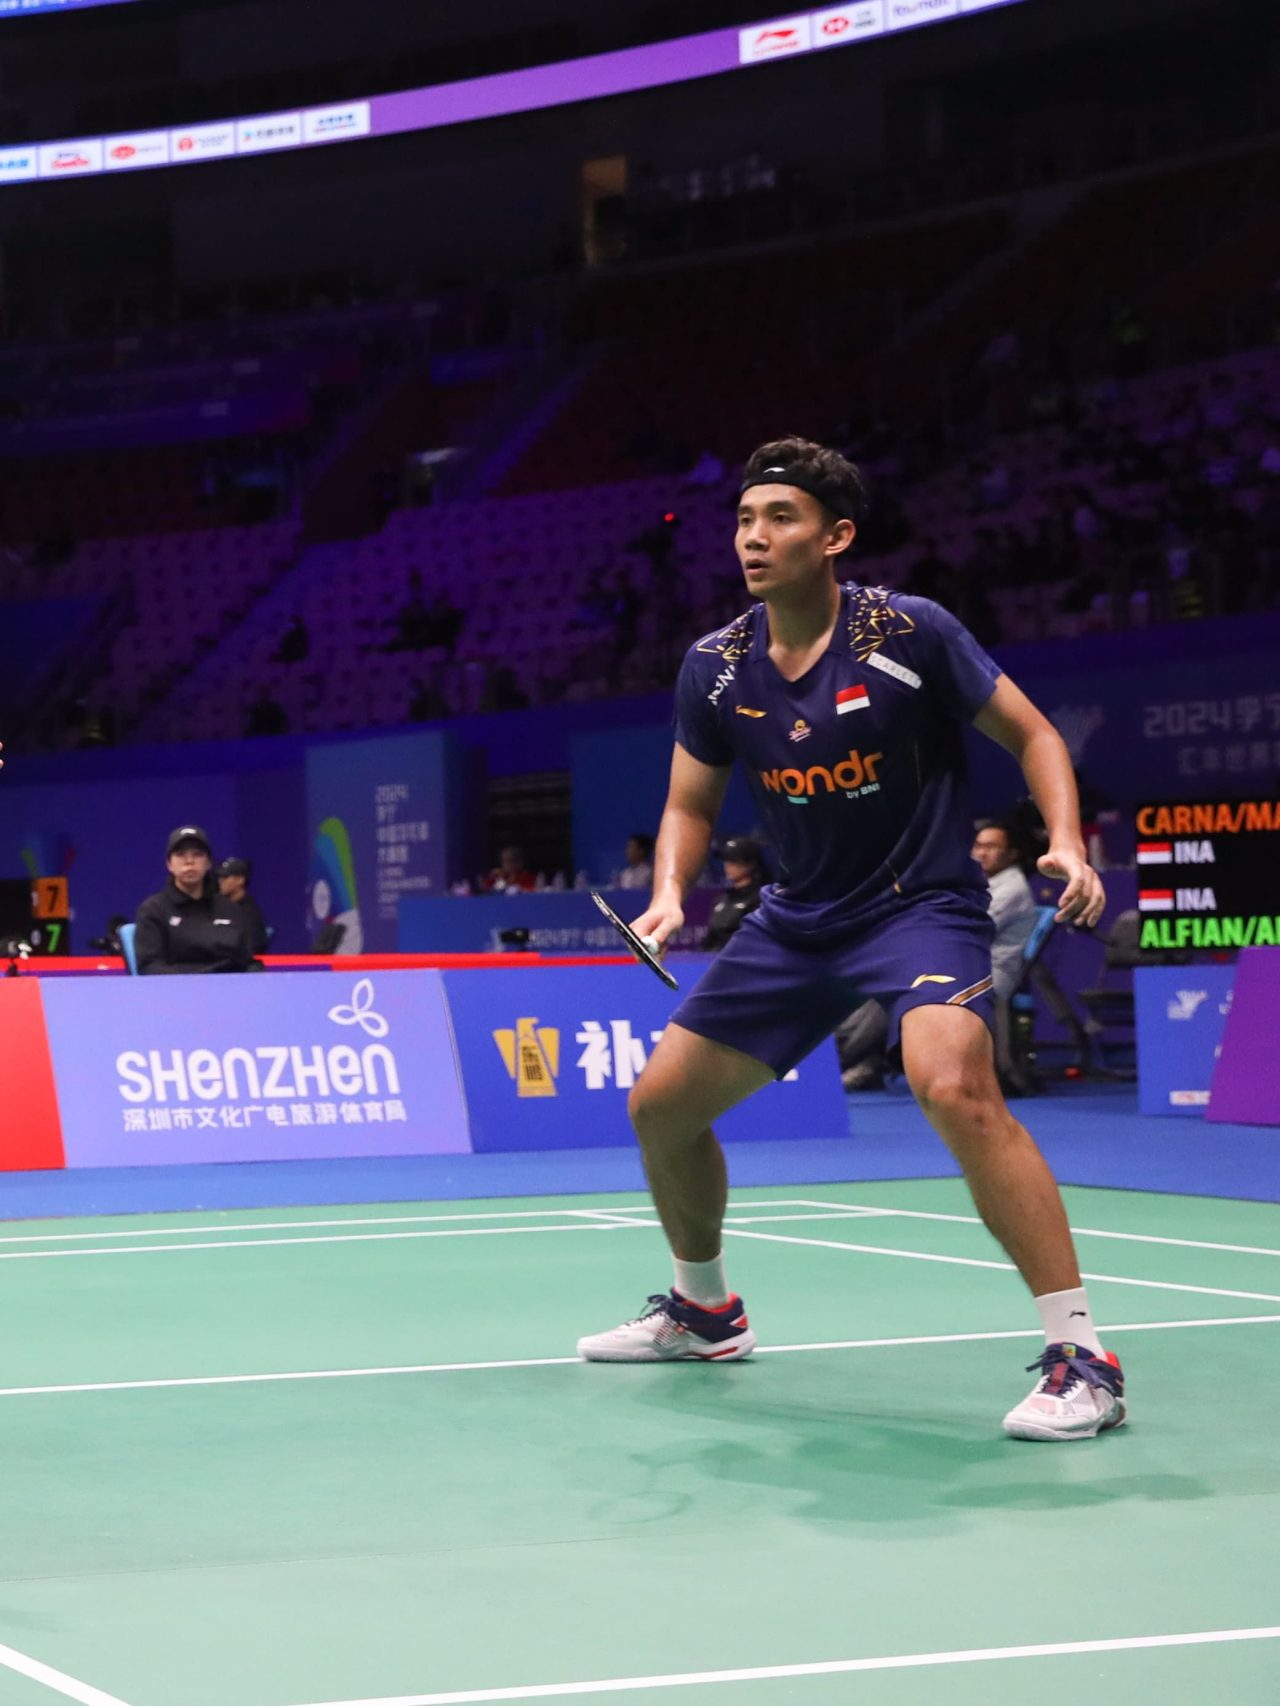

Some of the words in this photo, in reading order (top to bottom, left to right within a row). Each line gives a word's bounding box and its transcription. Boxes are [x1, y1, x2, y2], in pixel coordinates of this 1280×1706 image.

[760, 750, 883, 797] wondr
[846, 790, 860, 800] by
[860, 783, 881, 795] BNI
[1174, 840, 1215, 864] INA
[46, 884, 61, 913] 7
[1176, 888, 1217, 911] INA
[45, 923, 62, 953] 7
[1140, 915, 1280, 949] ALFIAN/A
[575, 1020, 665, 1089] 补
[122, 1099, 409, 1132] 深圳市文化广电旅游体育局
